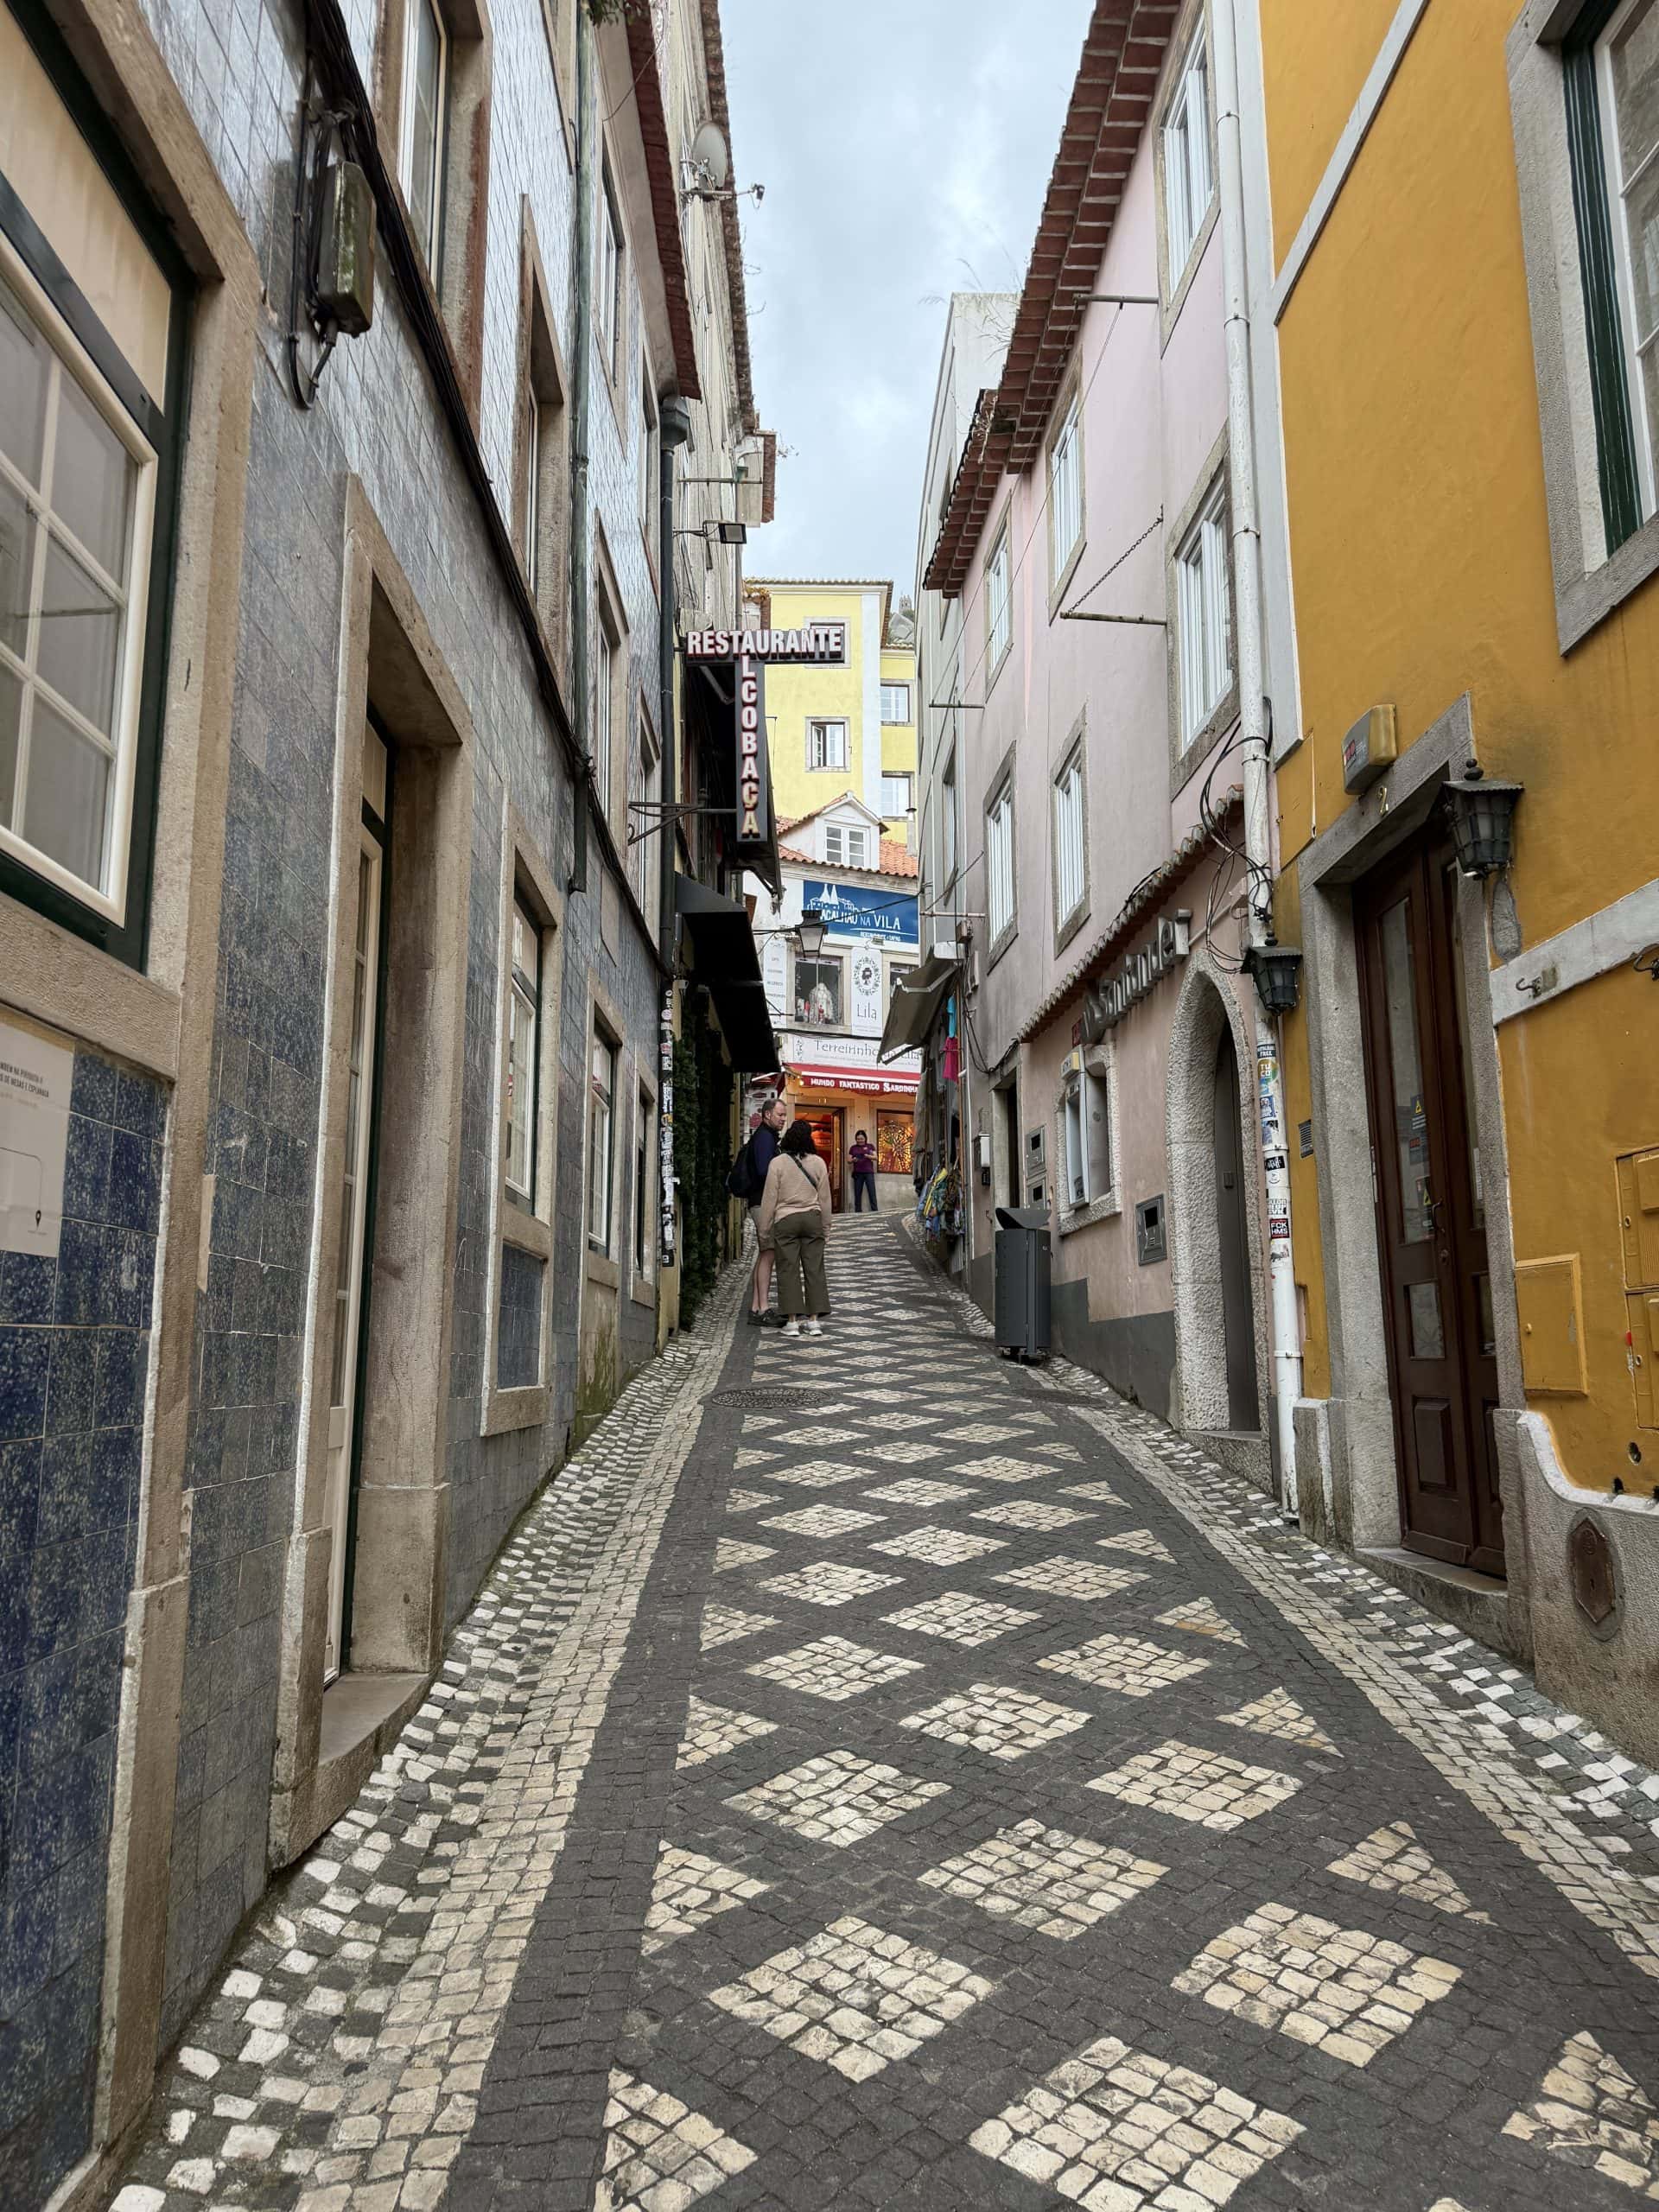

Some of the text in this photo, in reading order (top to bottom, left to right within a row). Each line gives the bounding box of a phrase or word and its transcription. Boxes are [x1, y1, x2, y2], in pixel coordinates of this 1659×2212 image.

[687, 629, 842, 658] RESTAURANTE
[874, 914, 901, 930] VILA
[856, 1001, 877, 1021] Lila
